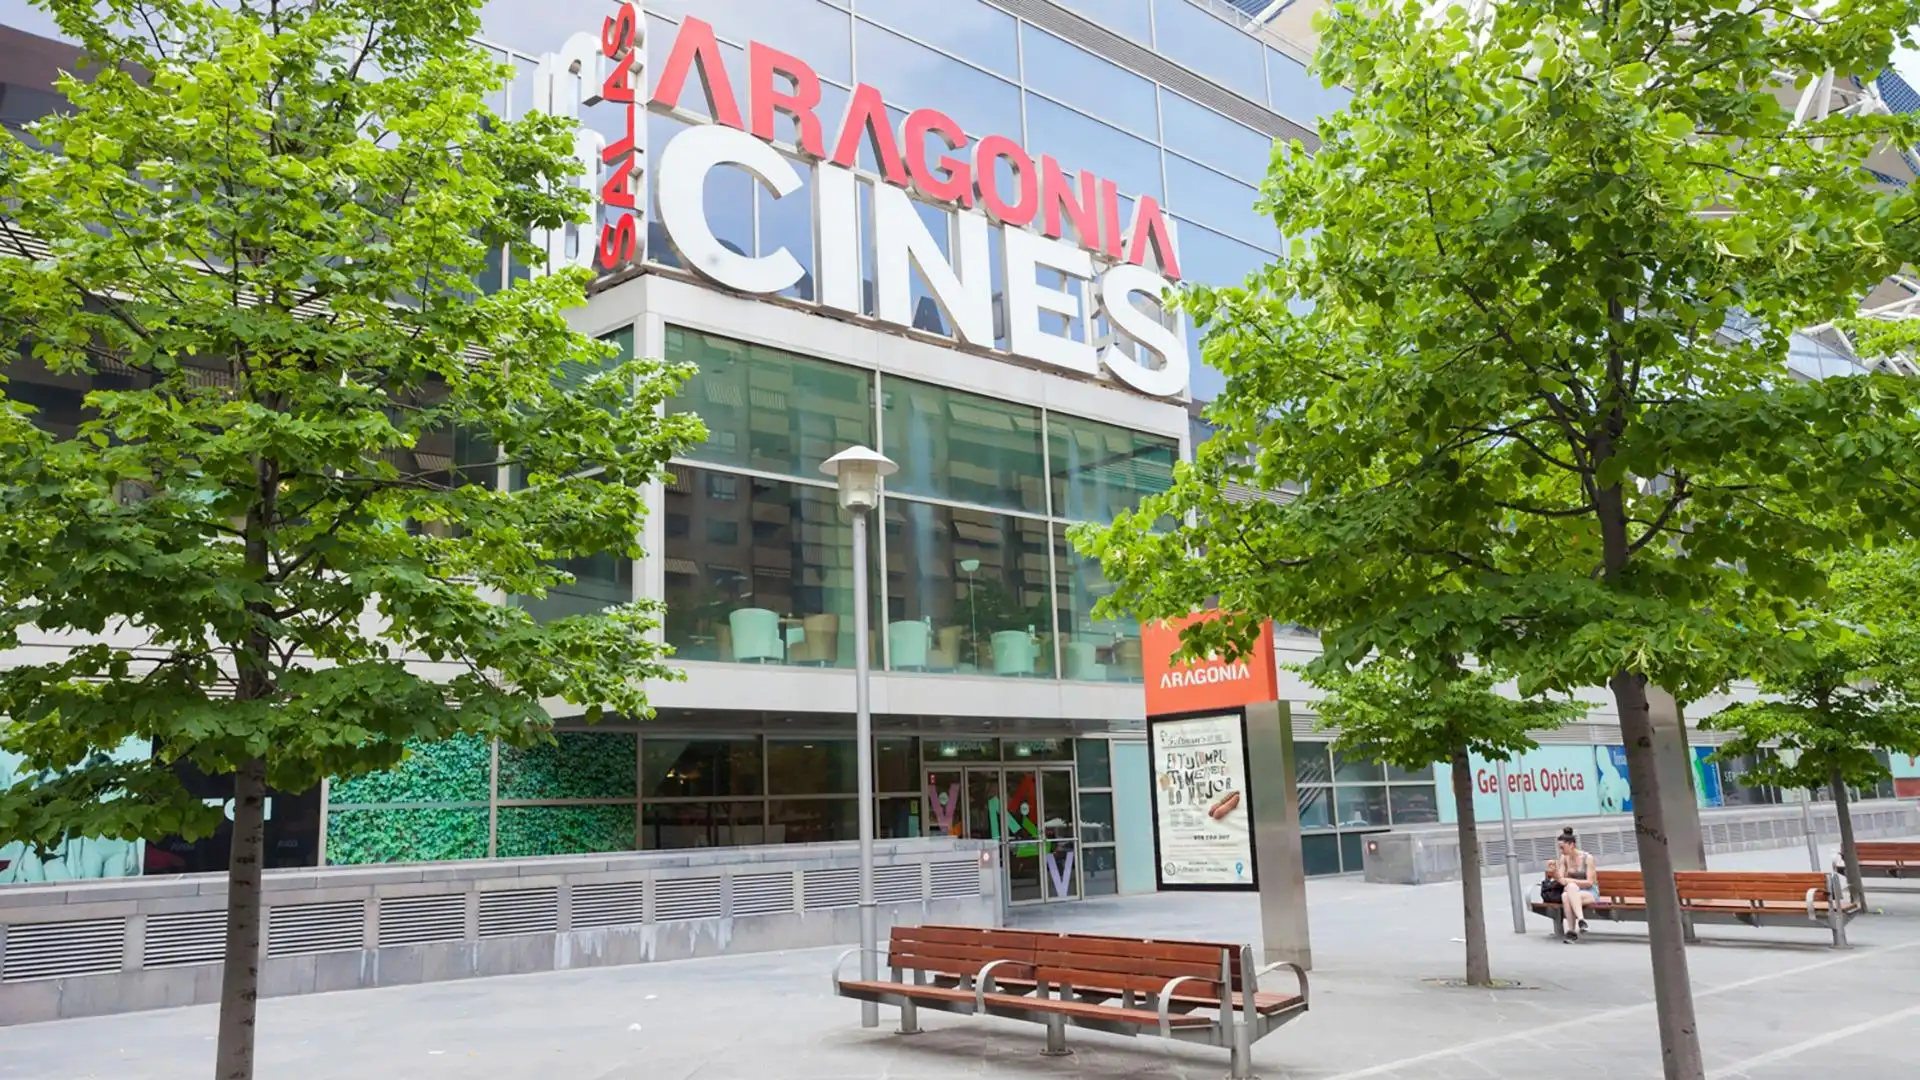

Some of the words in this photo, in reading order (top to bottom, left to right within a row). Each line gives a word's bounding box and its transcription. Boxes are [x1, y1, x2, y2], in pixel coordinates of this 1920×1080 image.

[601, 2, 636, 270] SALAS
[650, 15, 1182, 280] ARAGONIA
[657, 124, 1190, 396] CINES
[1160, 664, 1250, 689] ARAGONIA
[1477, 768, 1538, 794] Geeral
[1540, 767, 1584, 798] Optica
